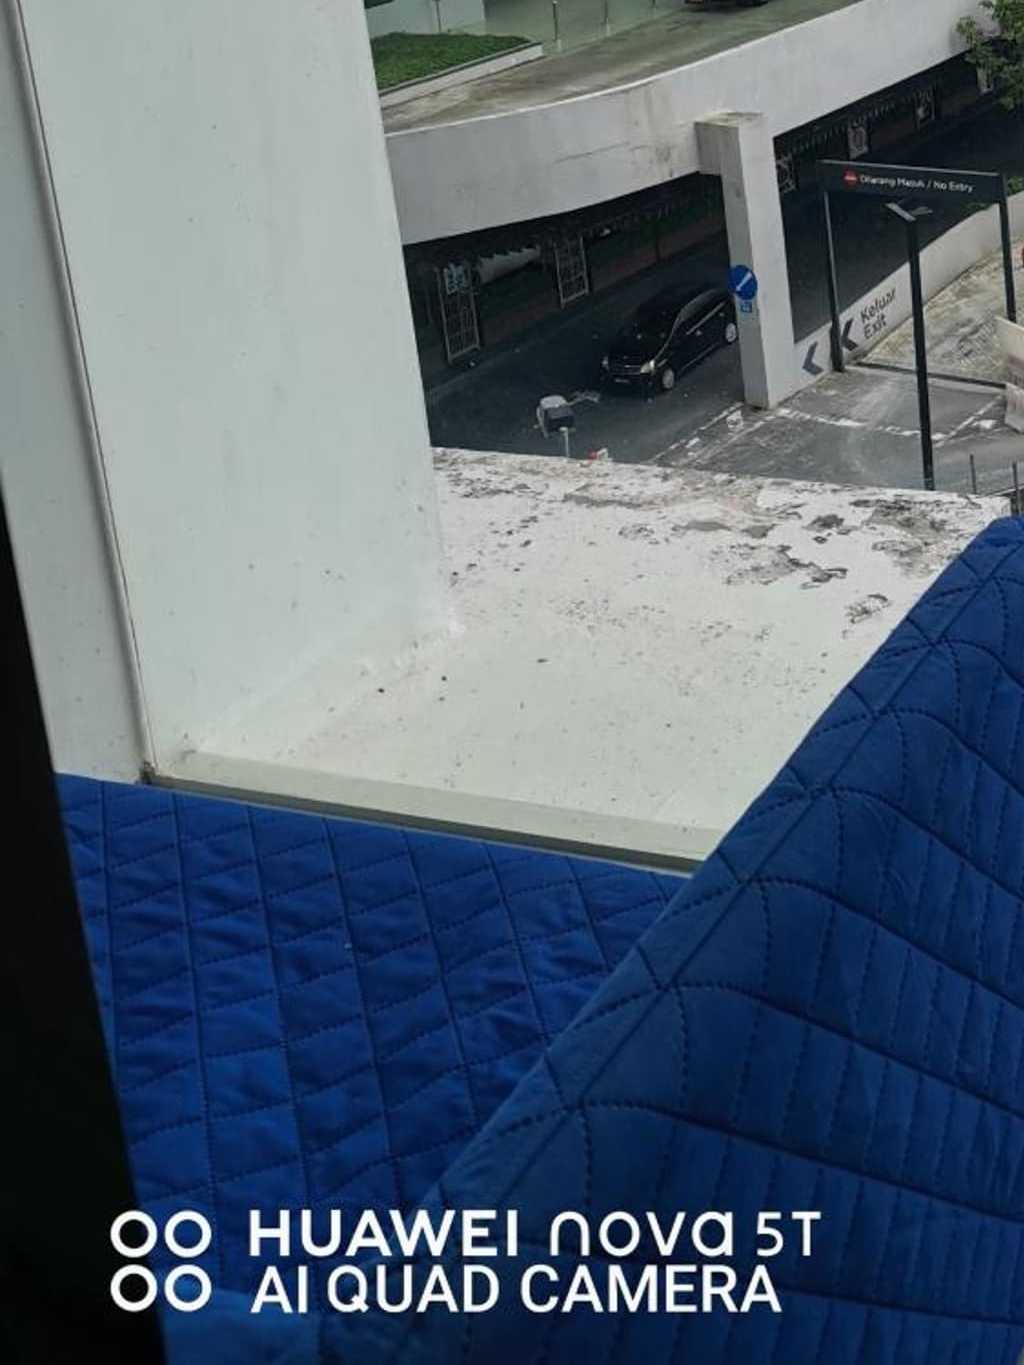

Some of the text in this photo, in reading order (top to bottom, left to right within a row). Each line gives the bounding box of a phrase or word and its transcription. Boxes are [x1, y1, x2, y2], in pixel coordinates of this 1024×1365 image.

[933, 180, 948, 190] No
[948, 181, 974, 194] Entry
[863, 314, 887, 340] Exit
